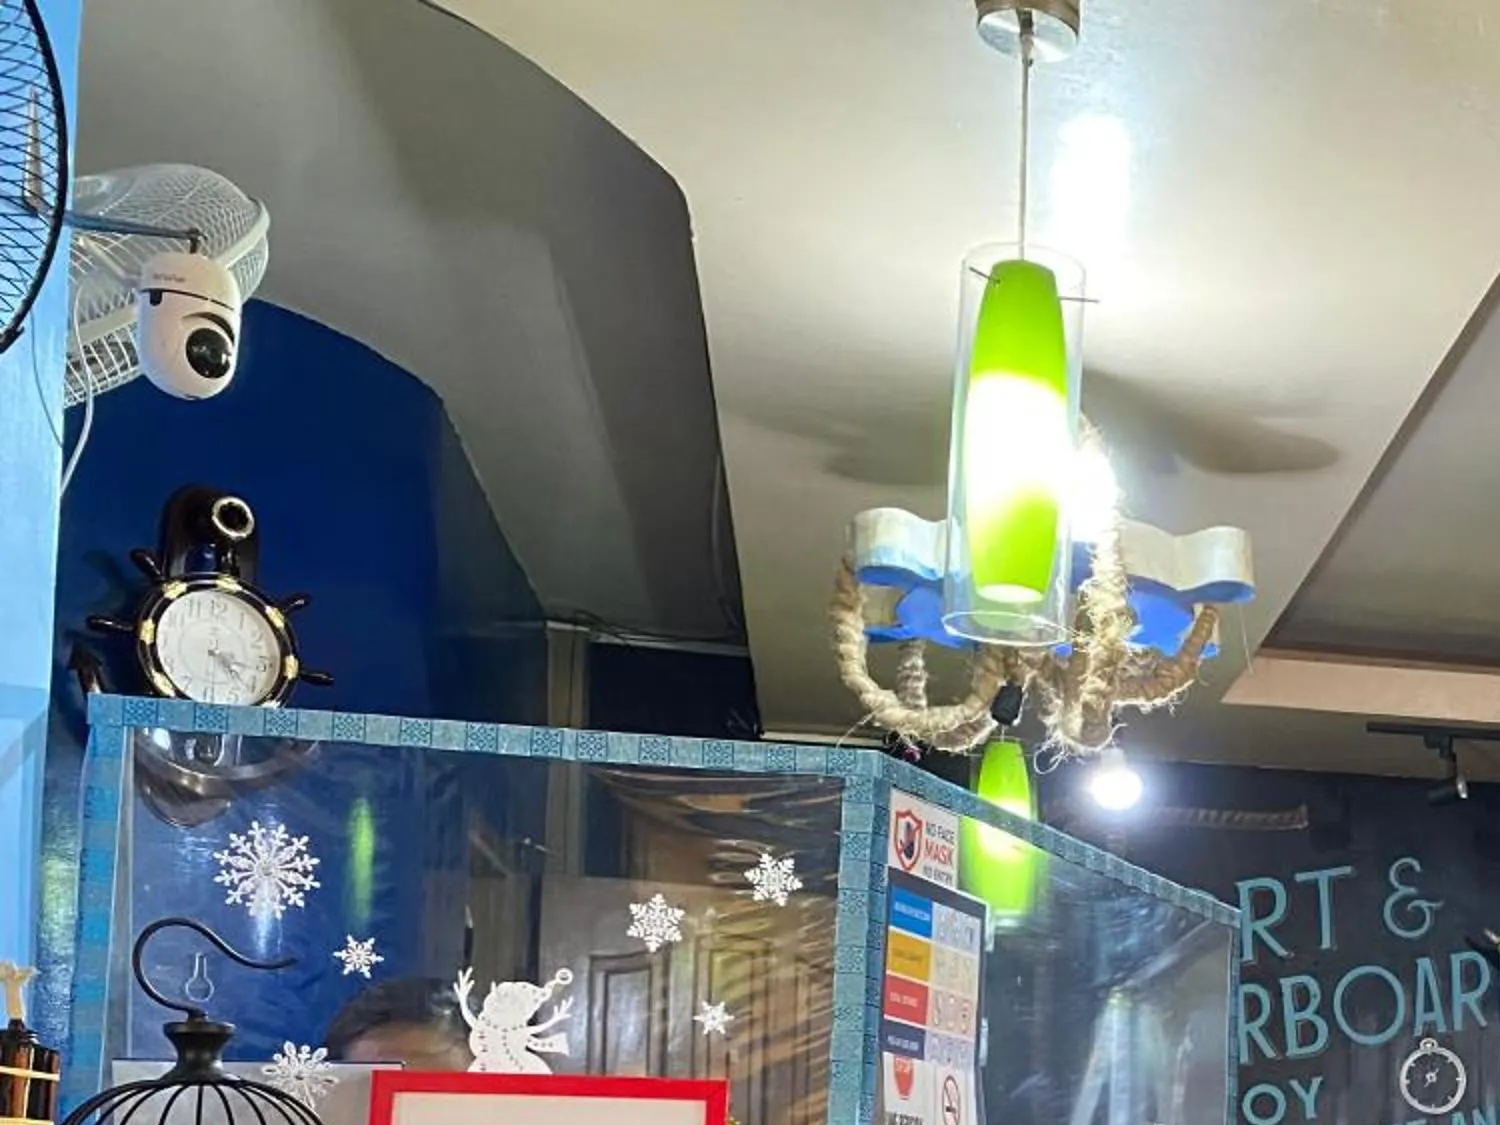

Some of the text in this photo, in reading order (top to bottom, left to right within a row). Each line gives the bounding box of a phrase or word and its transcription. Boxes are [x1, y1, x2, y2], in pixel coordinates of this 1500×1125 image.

[210, 599, 227, 618] 12
[251, 630, 264, 649] 2
[924, 838, 954, 866] MASK
[1235, 857, 1446, 965] RT &
